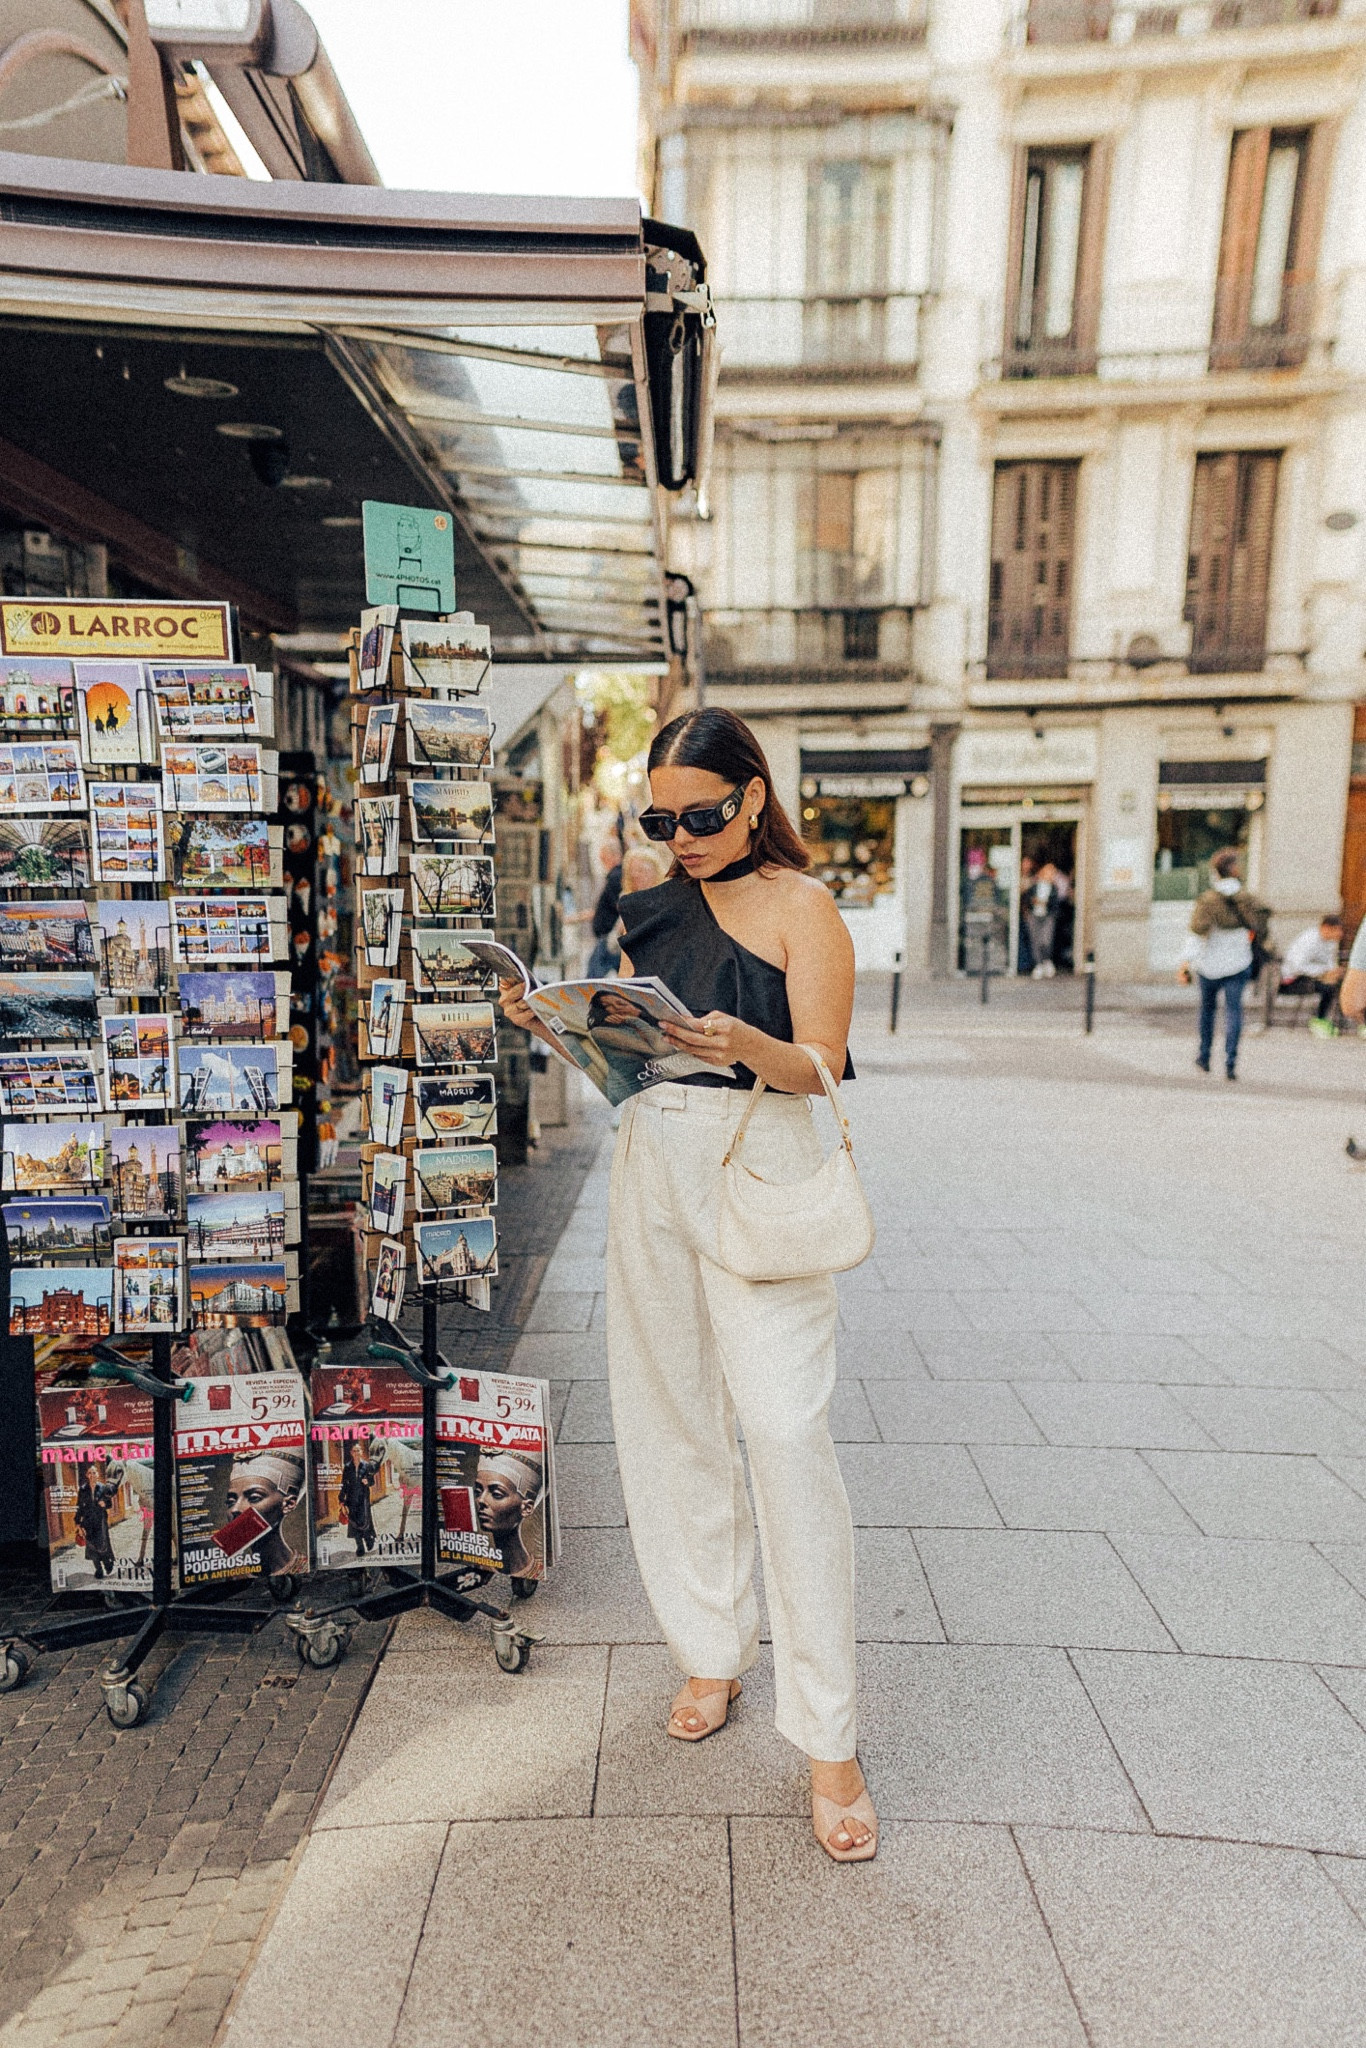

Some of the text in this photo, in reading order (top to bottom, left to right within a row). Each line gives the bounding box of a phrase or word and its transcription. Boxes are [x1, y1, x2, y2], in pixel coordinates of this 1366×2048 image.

[69, 613, 199, 639] LARROC
[435, 787, 470, 797] MADRID
[439, 1087, 475, 1098] MADRID
[435, 1153, 480, 1166] MADRID
[177, 1424, 279, 1450] muy
[311, 1421, 371, 1441] marie
[41, 1441, 154, 1464] marie clai
[177, 1441, 254, 1455] HISTORIA
[439, 1528, 490, 1546] MUJERES
[183, 1546, 230, 1563] MUJER
[378, 1541, 421, 1555] FIRM
[439, 1539, 503, 1561] PODEROSAS
[440, 1550, 450, 1558] DE
[184, 1553, 262, 1575] PODEROSAS
[184, 1574, 196, 1584] DE
[198, 1573, 209, 1581] LA
